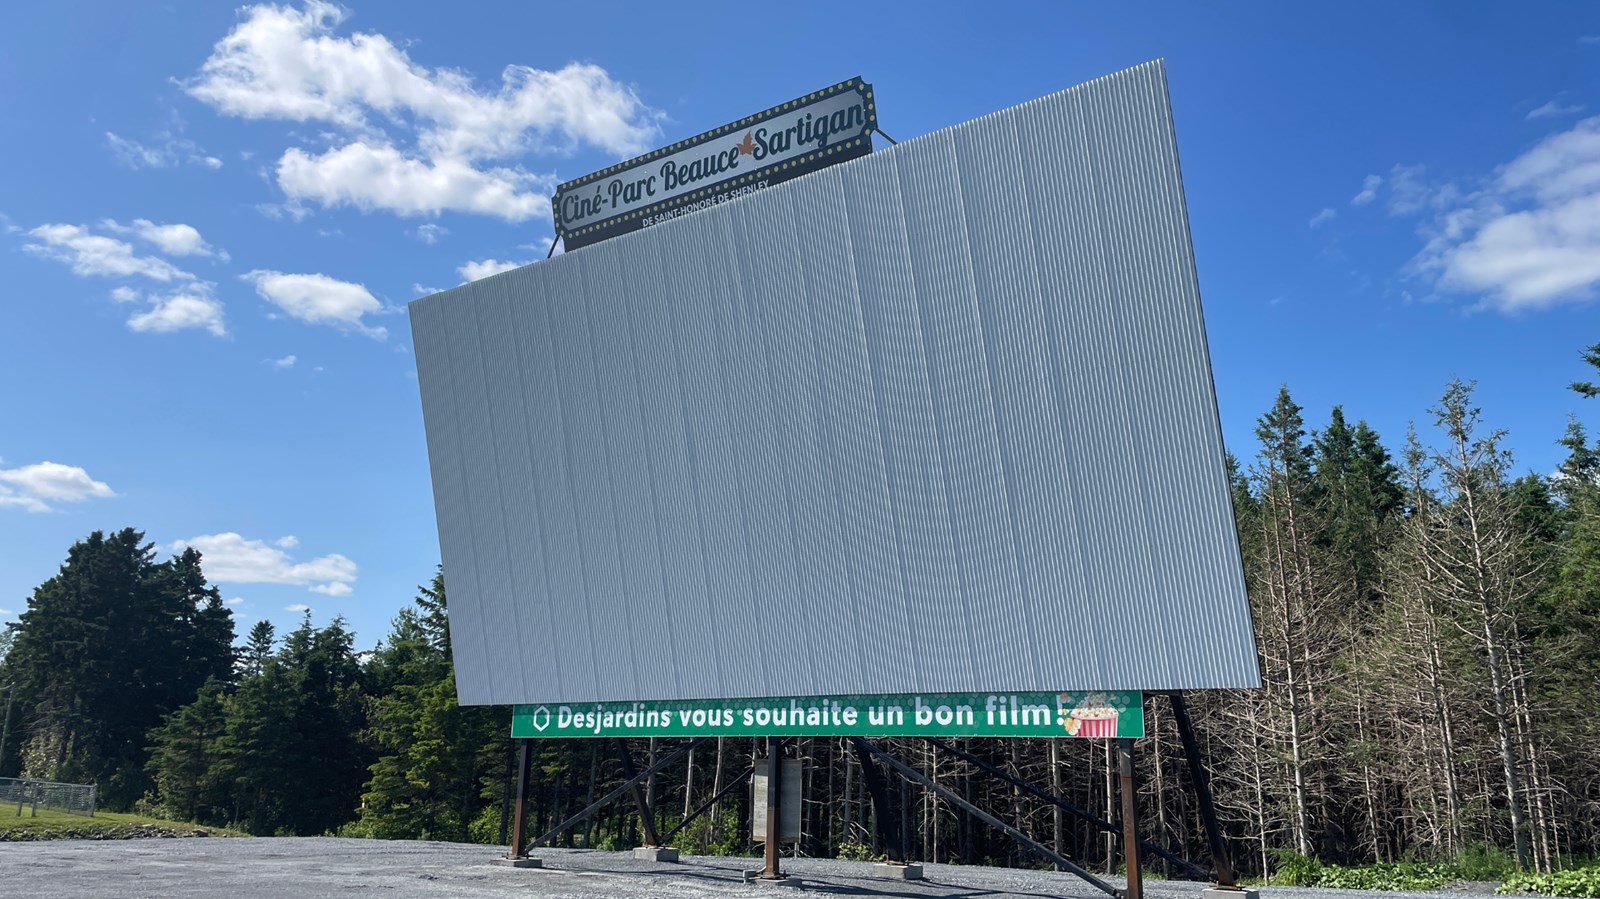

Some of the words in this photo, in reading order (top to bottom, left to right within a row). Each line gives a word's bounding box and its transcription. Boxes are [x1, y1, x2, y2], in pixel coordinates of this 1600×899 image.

[560, 175, 656, 224] Ciné-Parc
[659, 146, 739, 191] Beauce
[753, 102, 865, 161] Sartigan
[642, 217, 654, 228] DE
[654, 195, 717, 224] SAINT-HONORÉ
[718, 191, 730, 204] DE
[730, 180, 769, 200] SHENLEY
[557, 703, 671, 734] Desjardins
[680, 707, 736, 728] vous
[742, 698, 858, 727] souhaite
[868, 704, 904, 726] un
[915, 697, 974, 726] bon
